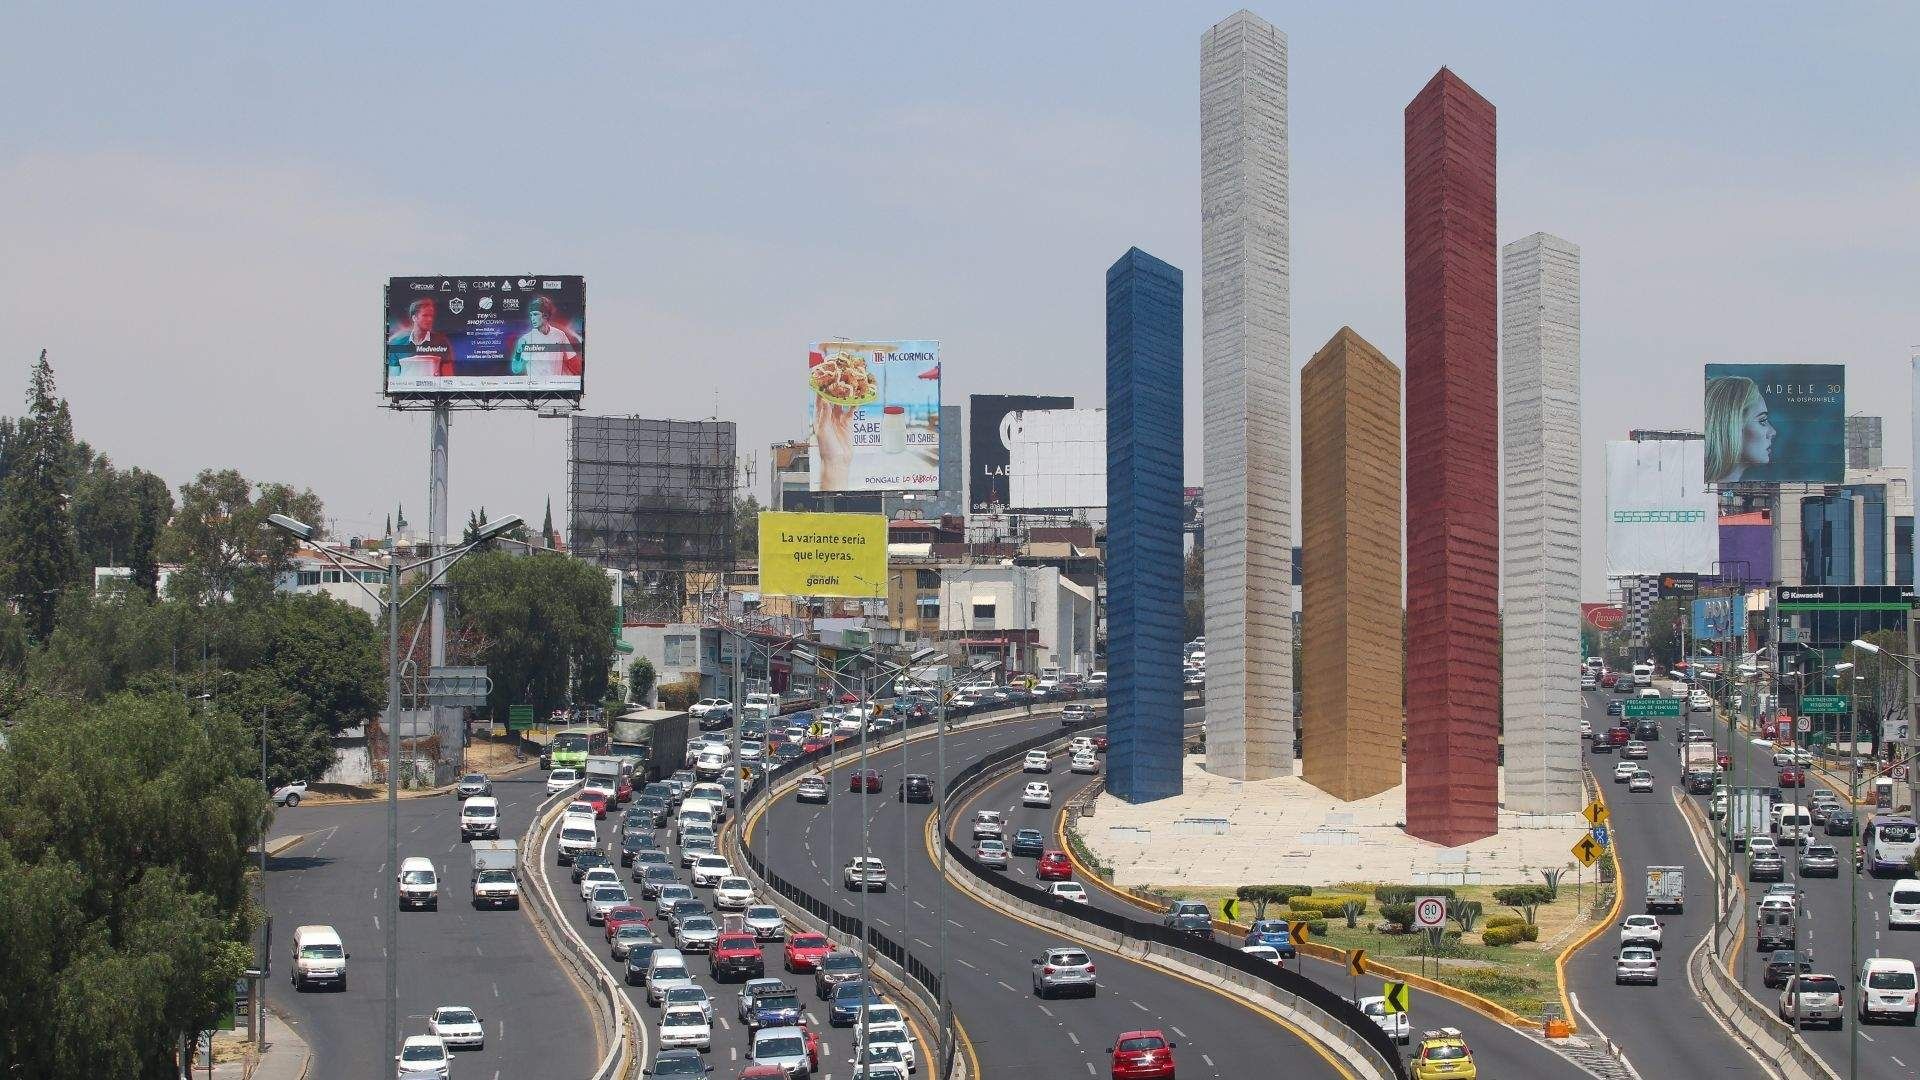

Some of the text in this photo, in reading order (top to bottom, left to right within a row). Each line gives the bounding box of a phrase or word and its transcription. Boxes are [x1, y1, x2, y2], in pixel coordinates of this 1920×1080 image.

[416, 345, 448, 353] Medvedev
[524, 344, 545, 352] Rublev
[1765, 384, 1841, 394] ADELE 30
[853, 411, 866, 421] SE
[853, 422, 880, 433] SABE
[854, 433, 867, 444] QUE
[868, 433, 881, 443] SIN
[906, 433, 916, 443] NO
[781, 532, 866, 545] La variante sería
[793, 549, 854, 563] que leyeras.
[806, 576, 840, 587] gandhi
[1885, 826, 1909, 835] CDMX
[1424, 904, 1437, 916] 80
